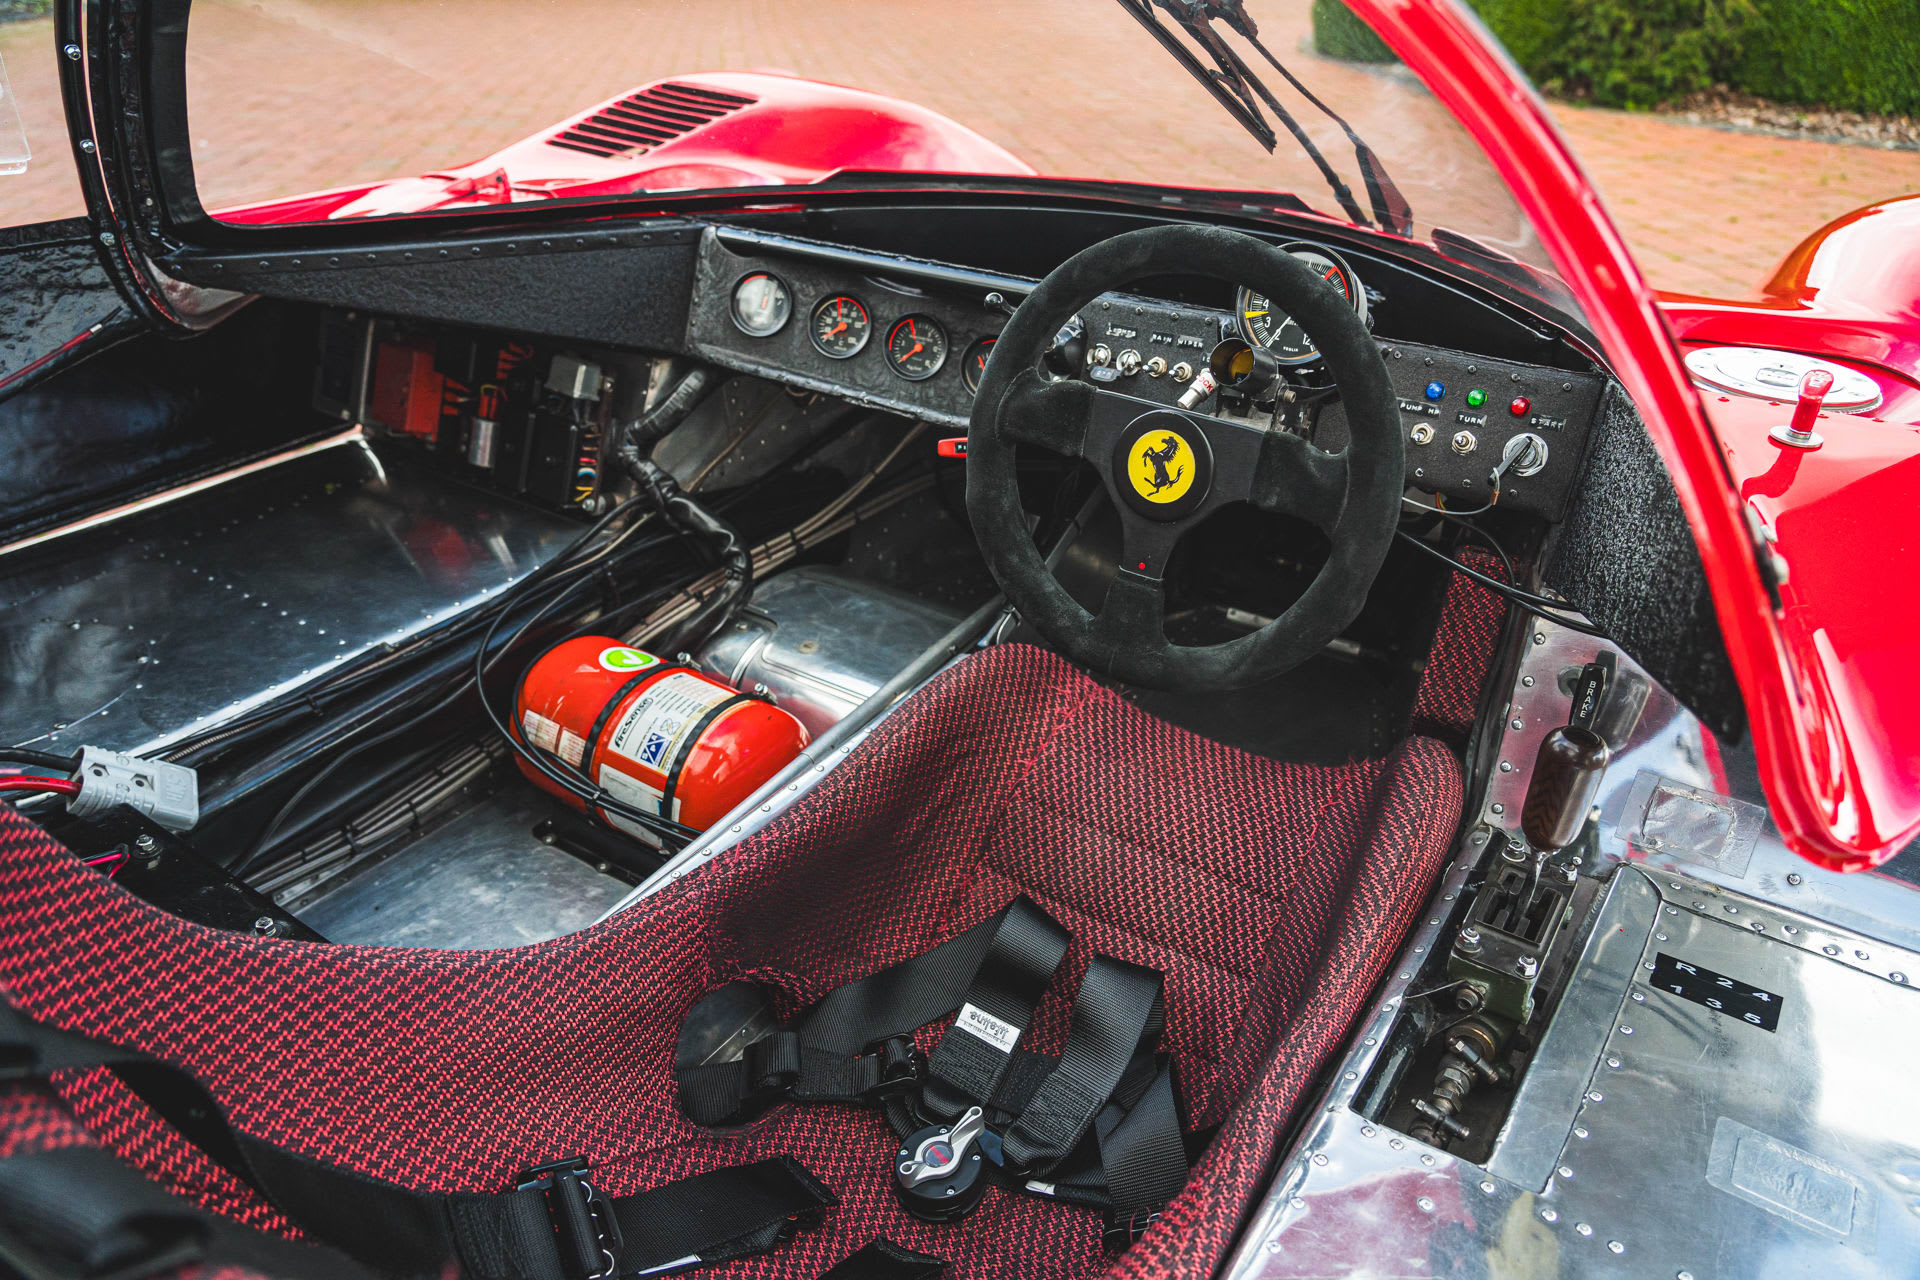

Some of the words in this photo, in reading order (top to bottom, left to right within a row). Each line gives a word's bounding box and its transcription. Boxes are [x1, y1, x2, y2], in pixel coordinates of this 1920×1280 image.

[1263, 299, 1270, 309] 4
[1264, 316, 1271, 328] 3
[1152, 333, 1173, 343] RAIN
[1177, 338, 1204, 348] WIPER
[1400, 402, 1422, 411] PUMP
[1459, 415, 1483, 425] TURN
[1530, 417, 1563, 428] START
[1580, 680, 1597, 718] BRAKE
[1675, 961, 1697, 976] R
[1716, 977, 1733, 989] 2
[1752, 992, 1771, 1002] 4
[1670, 984, 1683, 994] 1
[1705, 997, 1723, 1009] 3
[1743, 1012, 1762, 1024] 5
